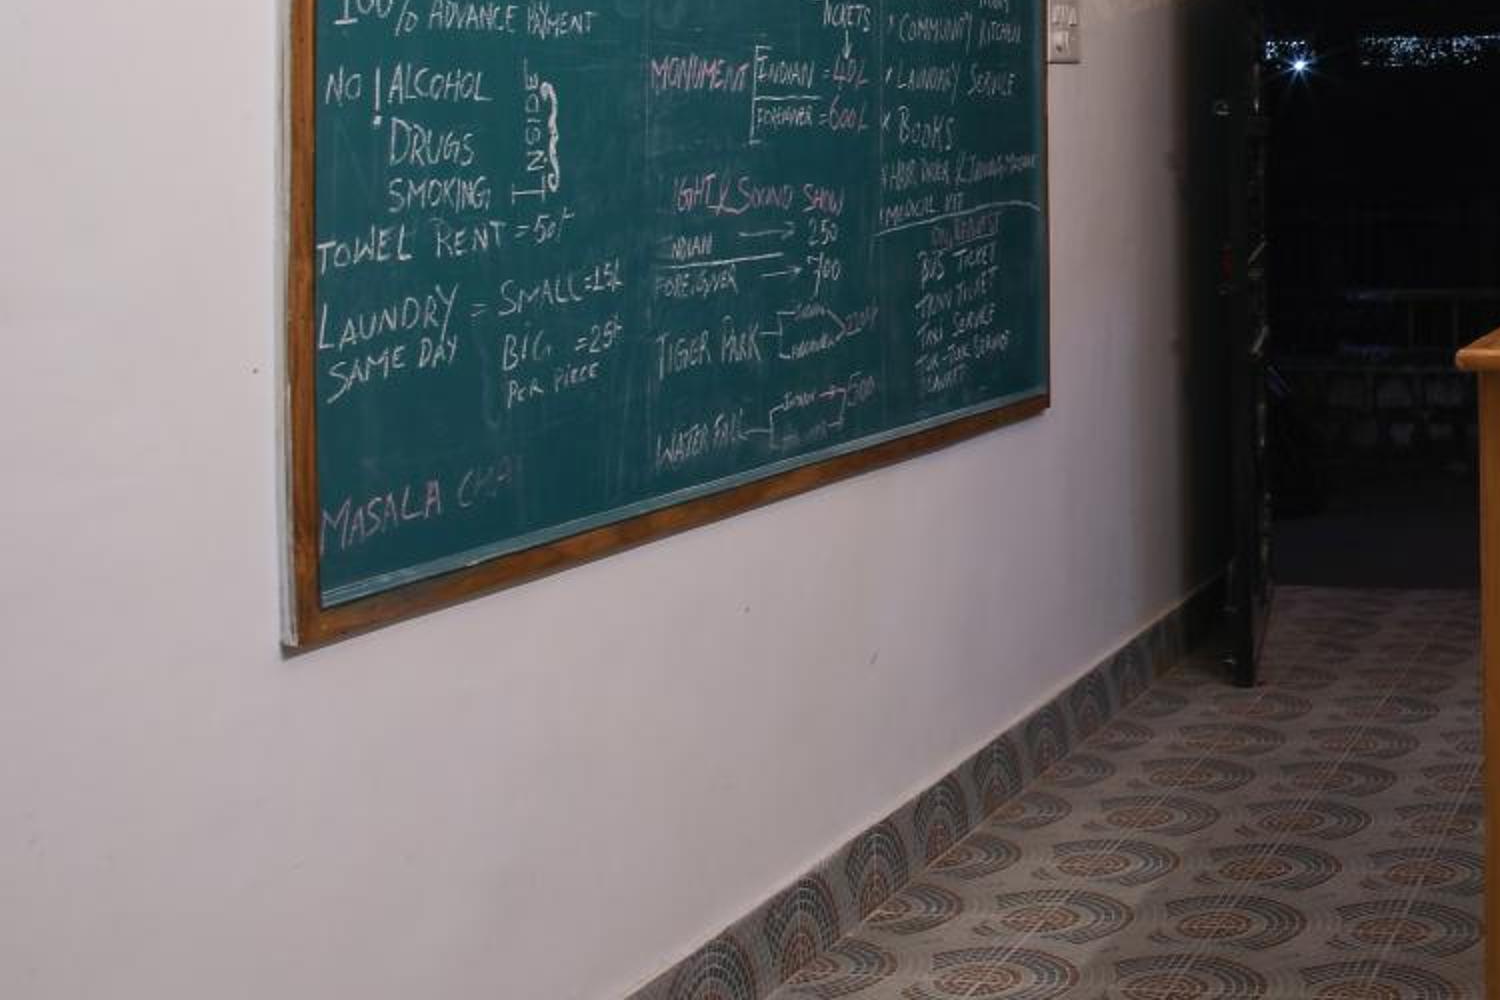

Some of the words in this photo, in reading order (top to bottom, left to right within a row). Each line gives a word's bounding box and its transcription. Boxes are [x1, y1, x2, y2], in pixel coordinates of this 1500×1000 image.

[325, 64, 362, 108] NO
[387, 62, 494, 105] ALCOHOL
[389, 115, 475, 168] DRUGS
[897, 104, 956, 152] BOOKS
[388, 175, 492, 215] SMOKING
[316, 224, 413, 275] TOWEL
[430, 216, 507, 259] RENT
[318, 283, 461, 352] LAUNDRY
[497, 278, 583, 317] SMALL
[328, 346, 406, 404] SAME
[418, 334, 458, 369] DAY
[502, 329, 551, 373] BIG
[320, 480, 441, 560] MASALA
